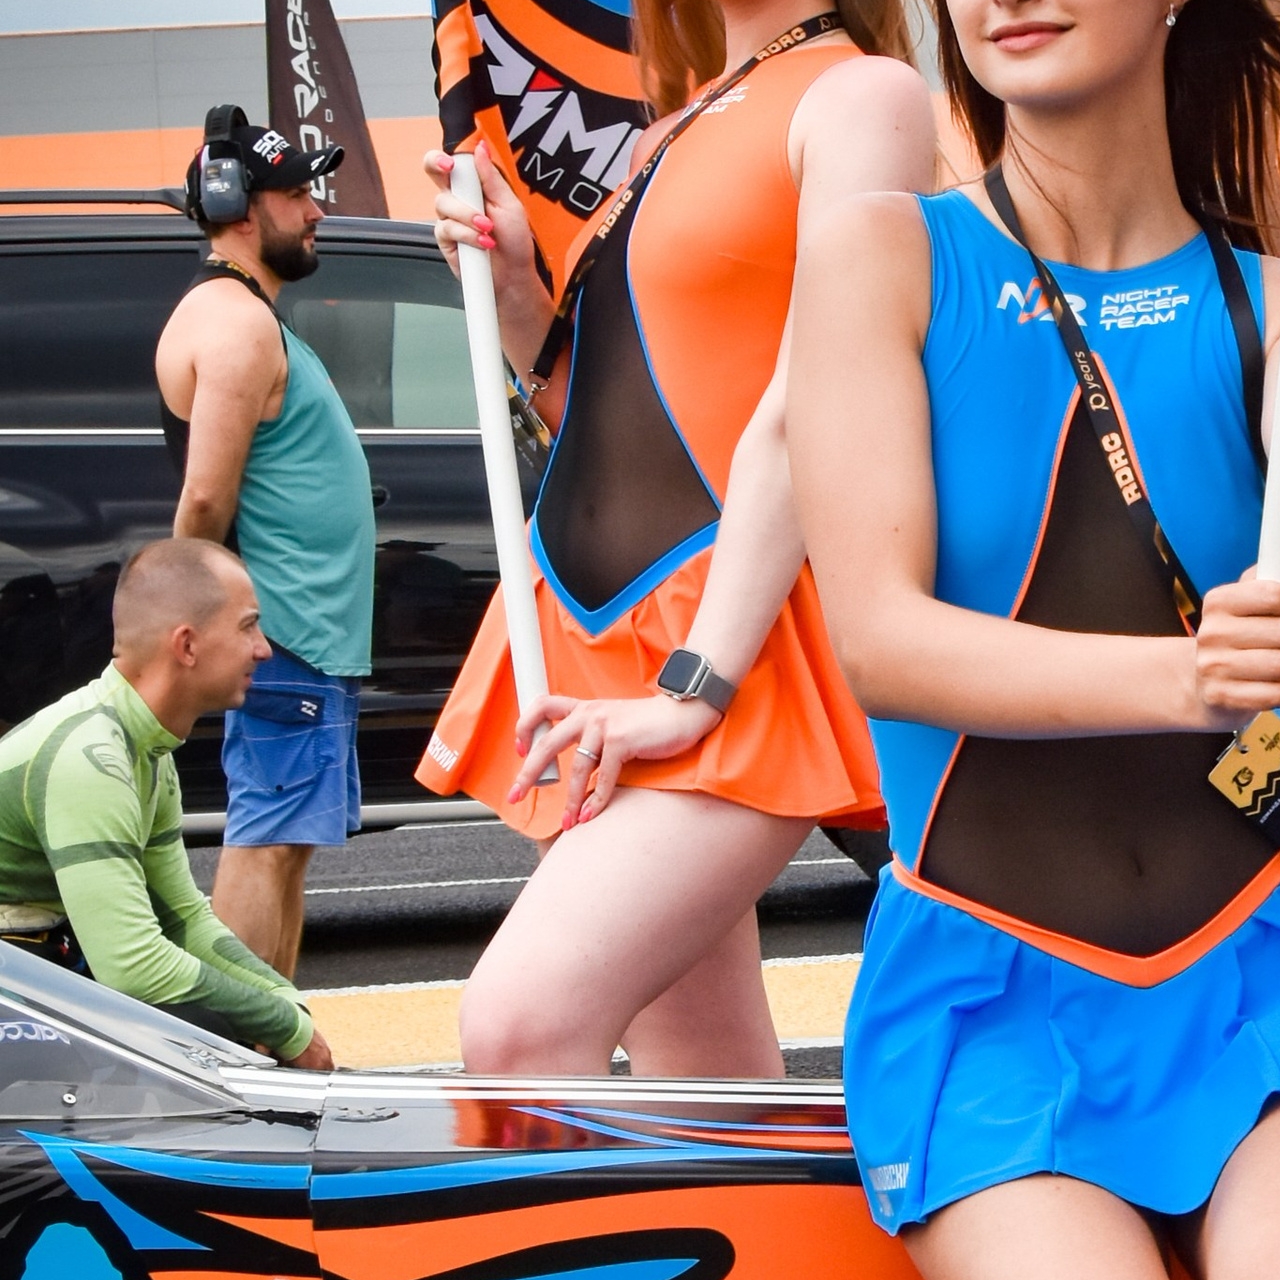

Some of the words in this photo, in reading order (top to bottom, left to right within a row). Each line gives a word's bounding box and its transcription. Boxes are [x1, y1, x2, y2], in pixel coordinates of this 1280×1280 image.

[754, 26, 807, 62] RDRC
[652, 133, 675, 162] years
[597, 189, 633, 239] RDRC
[1100, 295, 1190, 318] RACER
[1102, 285, 1179, 305] NIGHT
[1099, 310, 1176, 331] TEAM
[1075, 351, 1102, 390] years
[1101, 432, 1142, 506] RDRC
